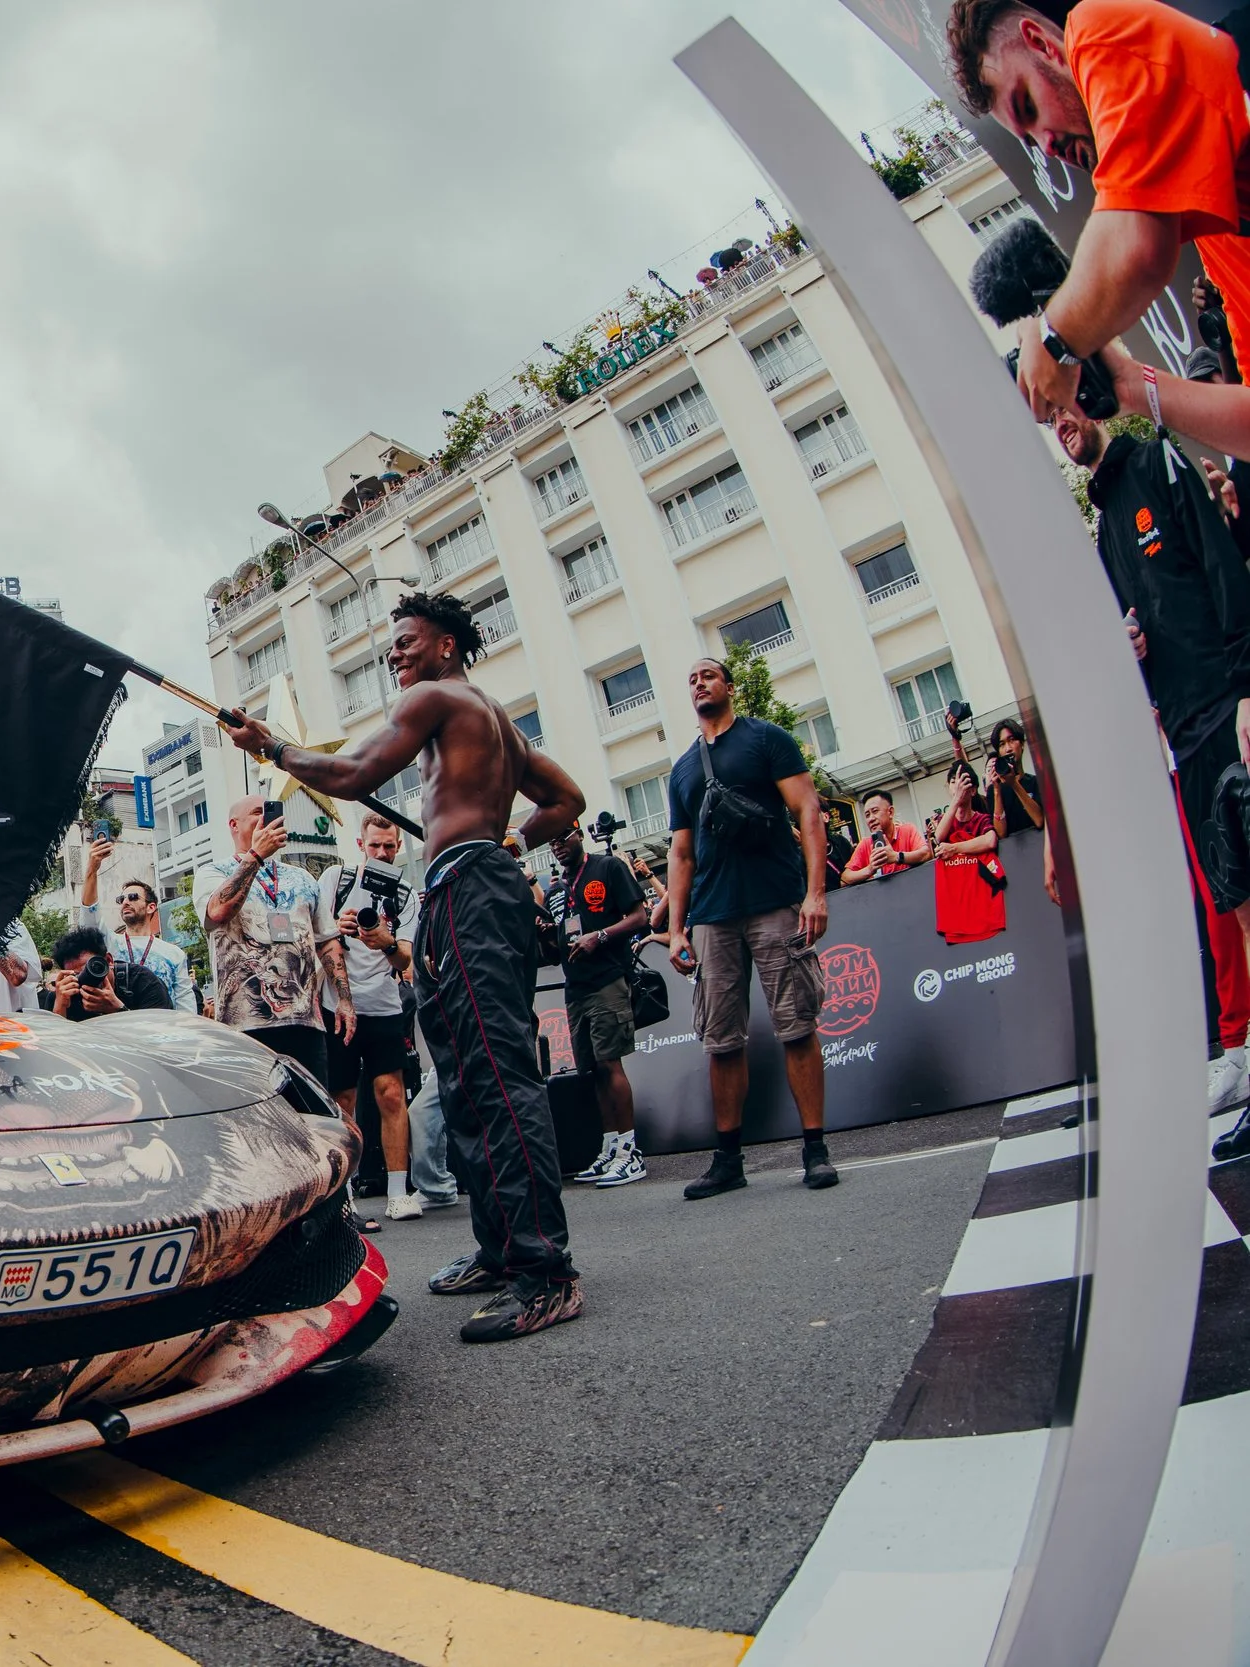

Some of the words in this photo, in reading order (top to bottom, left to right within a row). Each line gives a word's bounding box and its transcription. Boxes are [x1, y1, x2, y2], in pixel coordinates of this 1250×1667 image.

[575, 318, 678, 394] ROLEX
[147, 731, 192, 765] EXIMBANK
[140, 781, 150, 822] EXIMBANK
[286, 831, 337, 845] etcombank
[944, 856, 978, 866] vodafon
[944, 964, 974, 982] CHIP
[975, 952, 1015, 974] MONG
[976, 965, 1016, 984] GROUP
[825, 970, 877, 998] ALL
[654, 1032, 697, 1047] NARDIN
[823, 1041, 879, 1070] SINGAPORE
[42, 1239, 183, 1302] 551Q
[1, 1284, 27, 1299] MC
